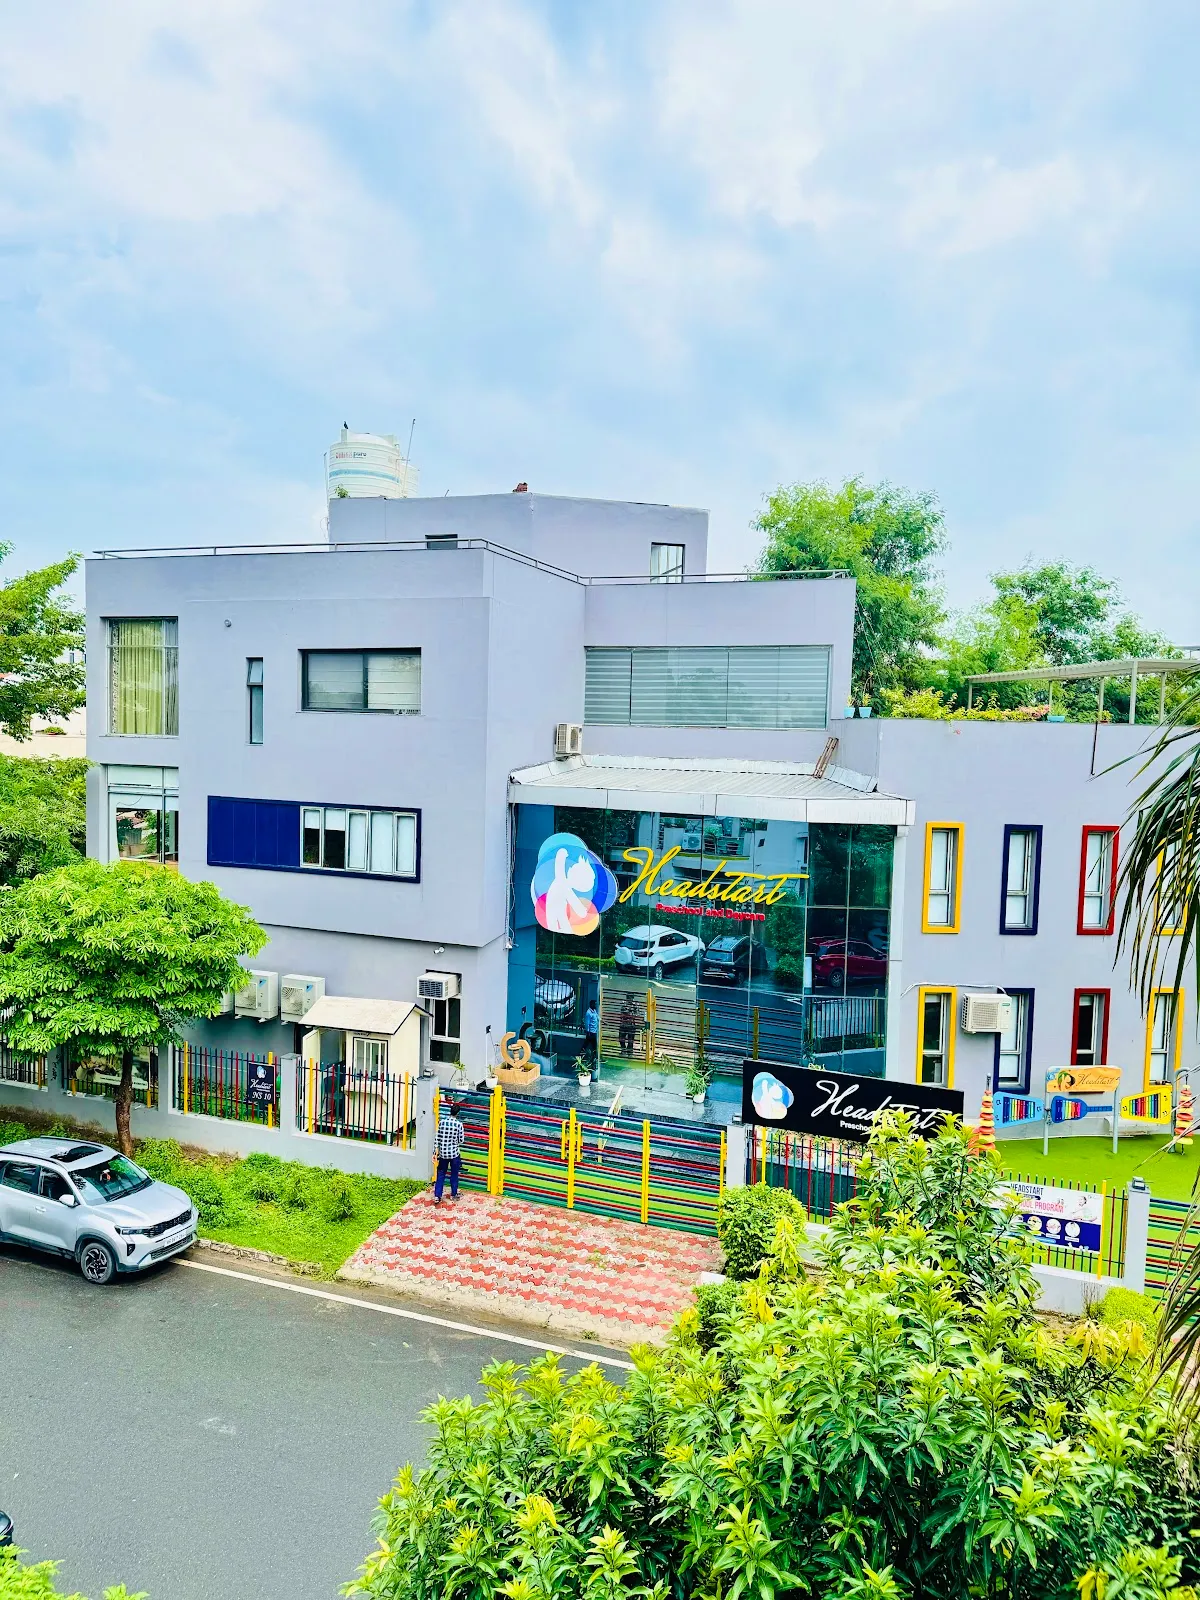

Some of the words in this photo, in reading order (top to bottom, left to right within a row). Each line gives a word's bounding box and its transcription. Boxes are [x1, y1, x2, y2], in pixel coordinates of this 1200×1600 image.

[618, 845, 810, 906] Headstart
[655, 902, 704, 916] Preschool
[705, 907, 725, 917] and
[725, 908, 766, 922] Daycare
[1076, 1073, 1115, 1087] Headstart
[264, 1092, 272, 1101] 10
